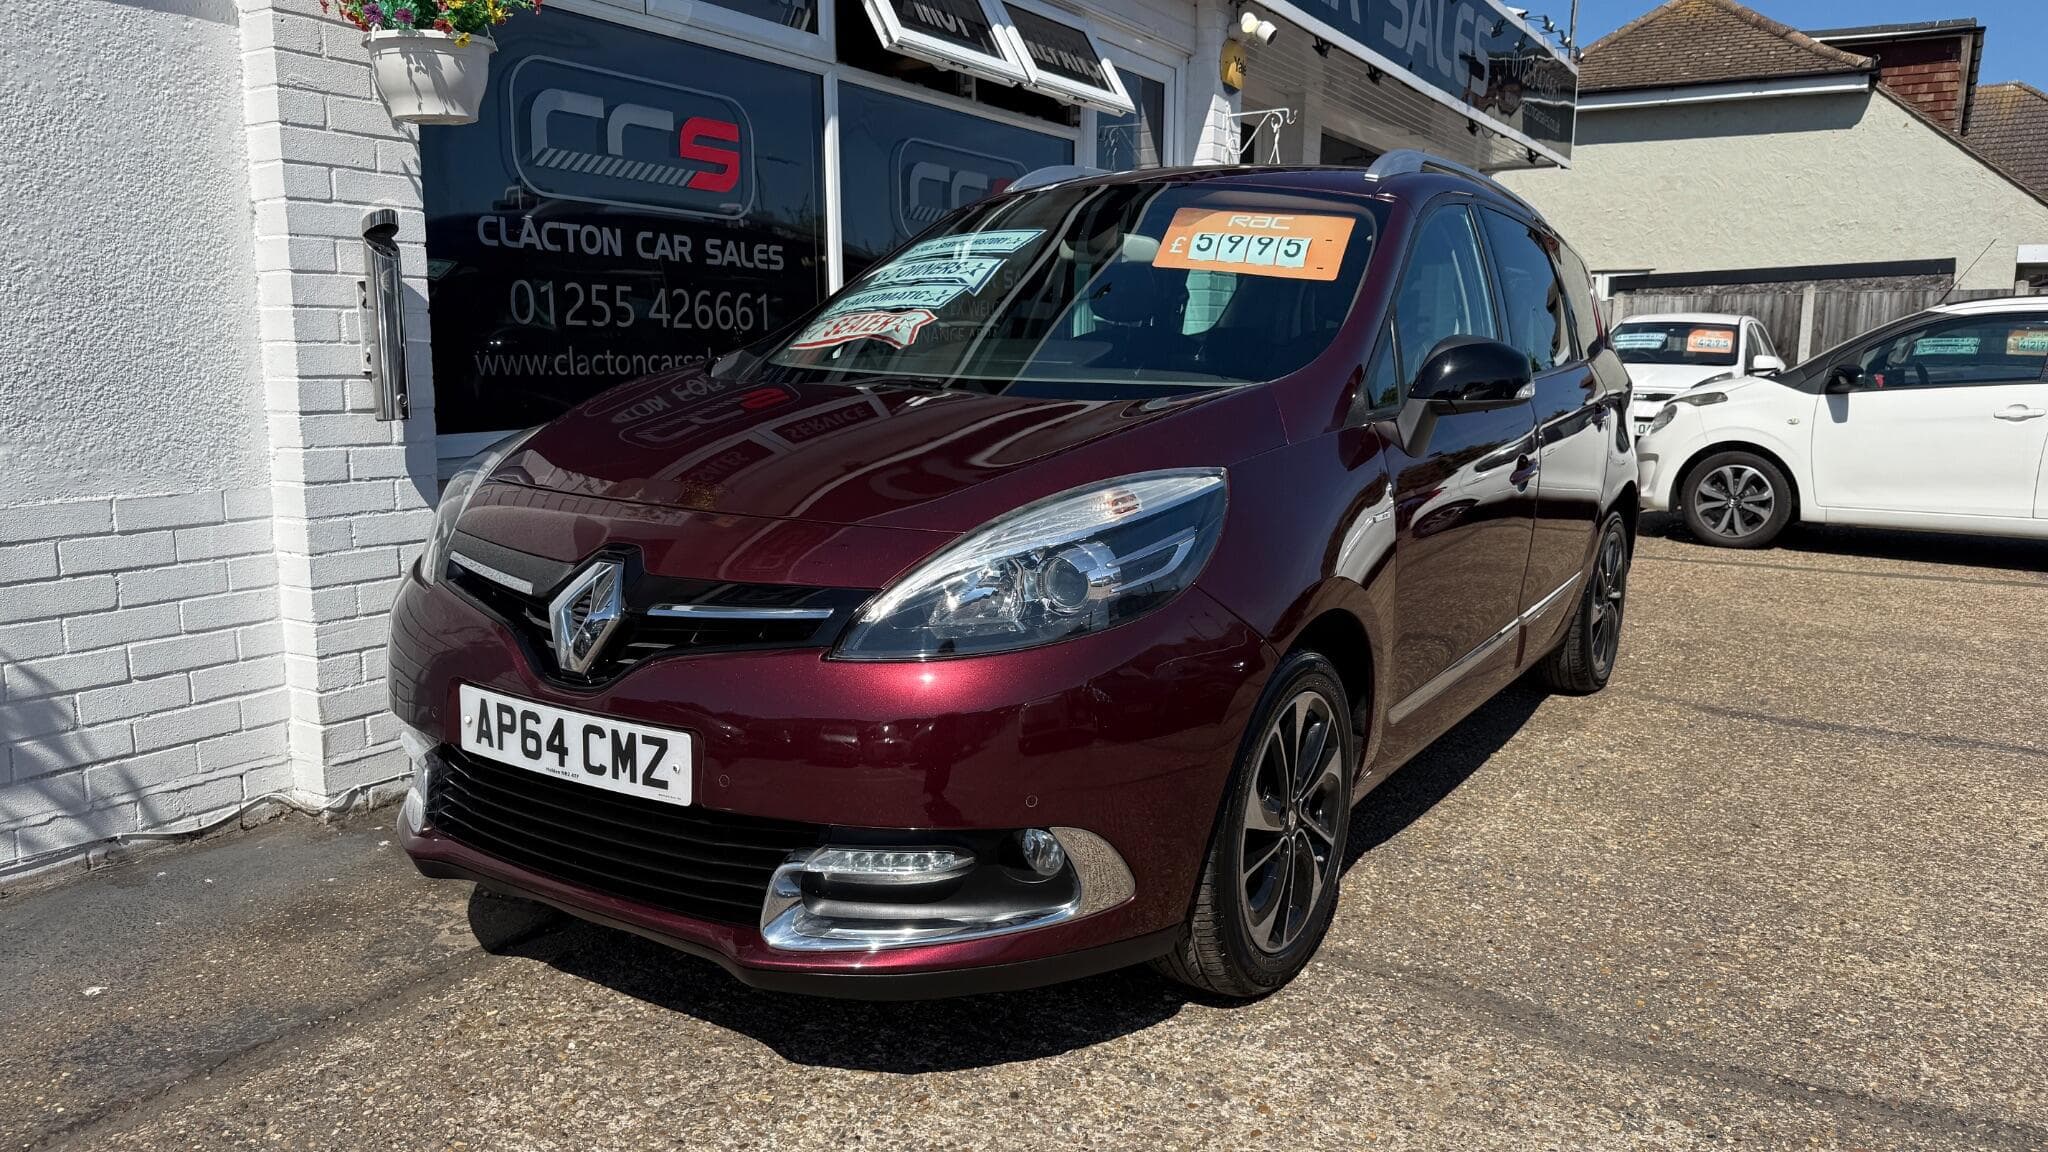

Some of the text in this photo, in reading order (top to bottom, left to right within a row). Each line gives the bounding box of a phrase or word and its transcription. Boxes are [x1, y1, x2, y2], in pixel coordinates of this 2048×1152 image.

[1384, 0, 1492, 97] SALES
[477, 216, 785, 271] CLACTON CAR SALES
[896, 262, 969, 279] OWNERS
[510, 278, 770, 331] 01255 426661
[853, 290, 929, 306] AUTOMATIC
[823, 314, 897, 338] SEATER
[476, 697, 669, 791] AP64 CMZ
